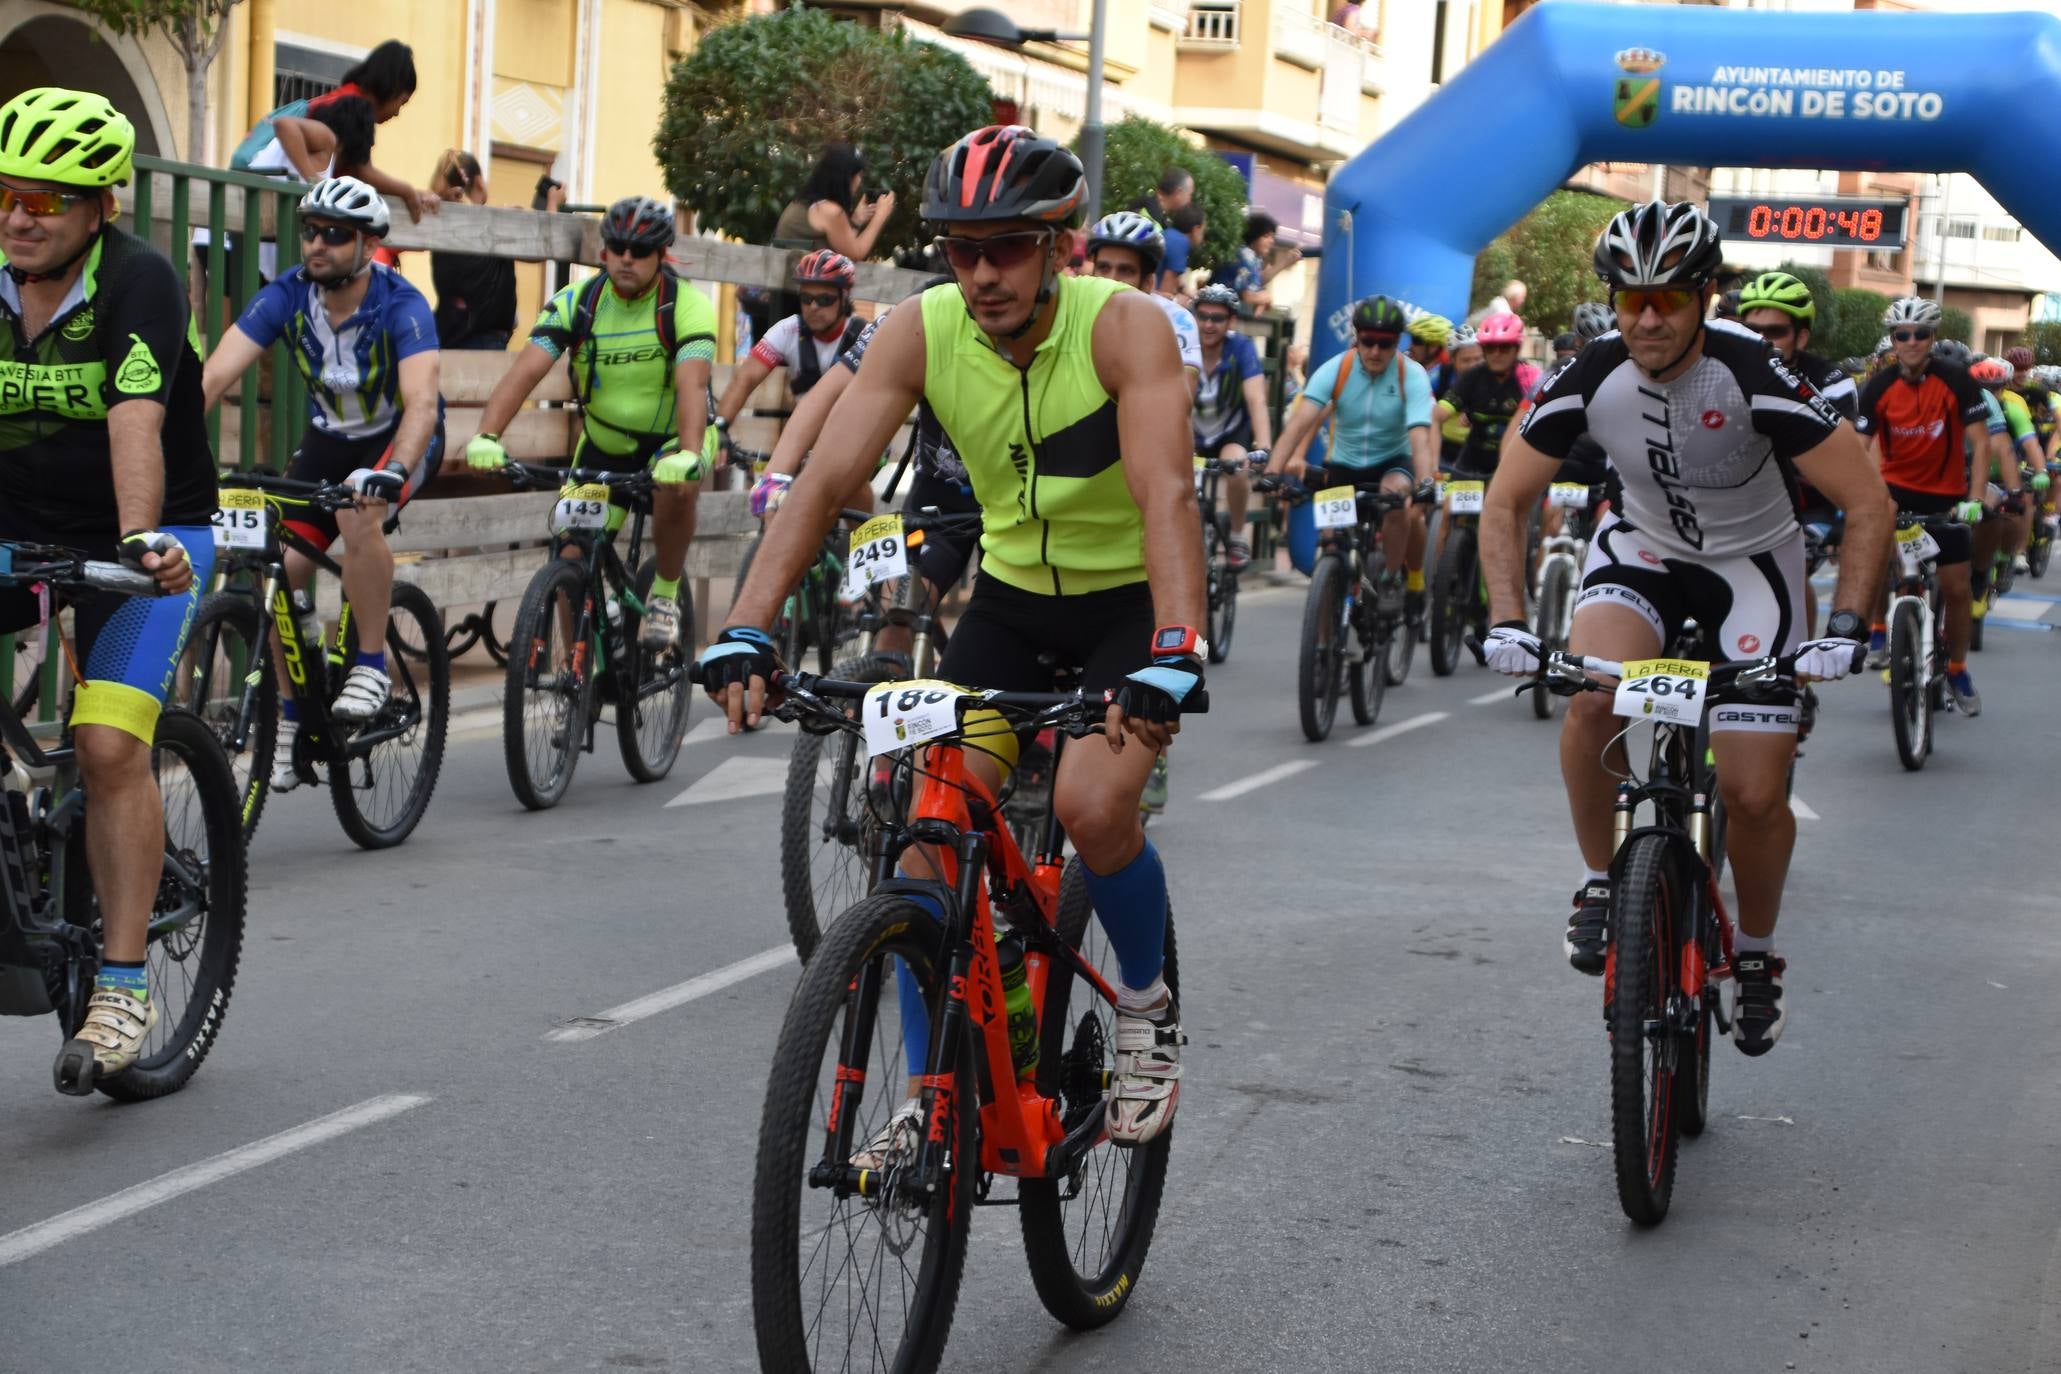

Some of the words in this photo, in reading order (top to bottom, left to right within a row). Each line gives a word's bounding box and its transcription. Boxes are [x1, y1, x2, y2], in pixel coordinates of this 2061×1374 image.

[1712, 66, 1872, 88] AYUNTAMIENTO
[1876, 70, 1905, 88] DE
[1671, 84, 1794, 116] RINCÓN
[1802, 90, 1846, 117] DE
[1852, 91, 1943, 121] SOTO
[1748, 205, 1883, 242] 0:00:48
[130, 350, 148, 359] BTT
[573, 348, 666, 366] ORBEA
[55, 368, 83, 381] BTT
[1456, 492, 1480, 502] 266
[562, 500, 602, 515] 143
[1320, 500, 1351, 514] 130
[210, 509, 258, 529] 215
[864, 520, 898, 537] PERA
[853, 537, 898, 569] 249
[273, 590, 306, 685] CUBE
[1627, 666, 1650, 677] LA
[1654, 664, 1703, 677] PERA
[1626, 675, 1697, 700] 264
[186, 987, 224, 1060] MAXXIS
